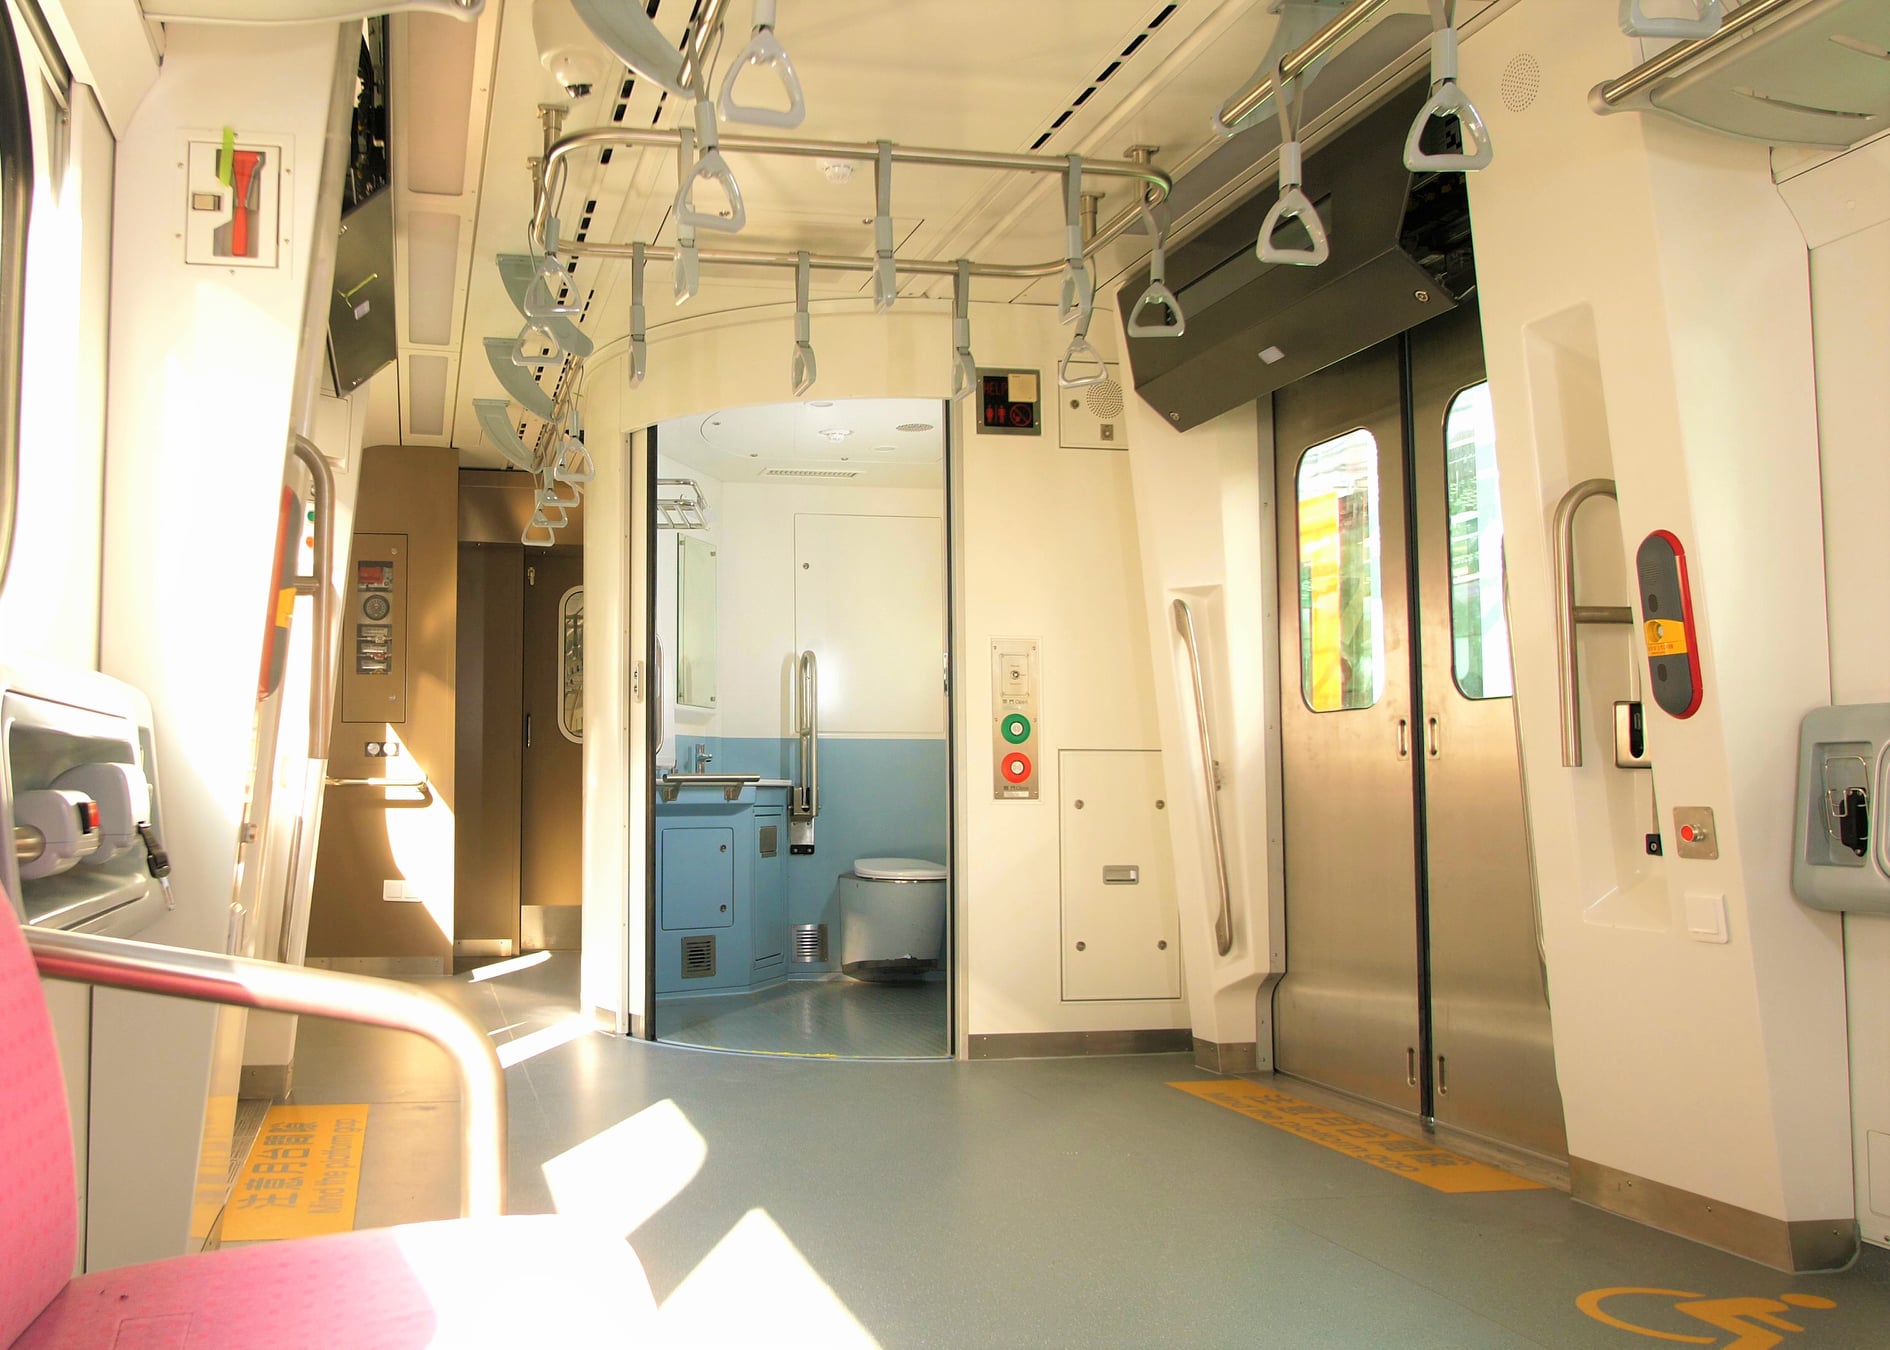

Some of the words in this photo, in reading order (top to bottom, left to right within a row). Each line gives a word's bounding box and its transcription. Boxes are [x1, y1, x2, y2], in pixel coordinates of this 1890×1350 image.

[984, 381, 1007, 396] HELP
[334, 1118, 362, 1132] gap
[1200, 1092, 1257, 1108] Mind
[1242, 1108, 1284, 1119] the
[1271, 1120, 1370, 1152] platform
[1356, 1153, 1421, 1173] gap
[1242, 1094, 1472, 1167] 注意月台間隙
[238, 1120, 318, 1209] 注意月台間隙
[319, 1134, 356, 1169] platform
[314, 1170, 347, 1186] the
[307, 1187, 344, 1214] Mind
